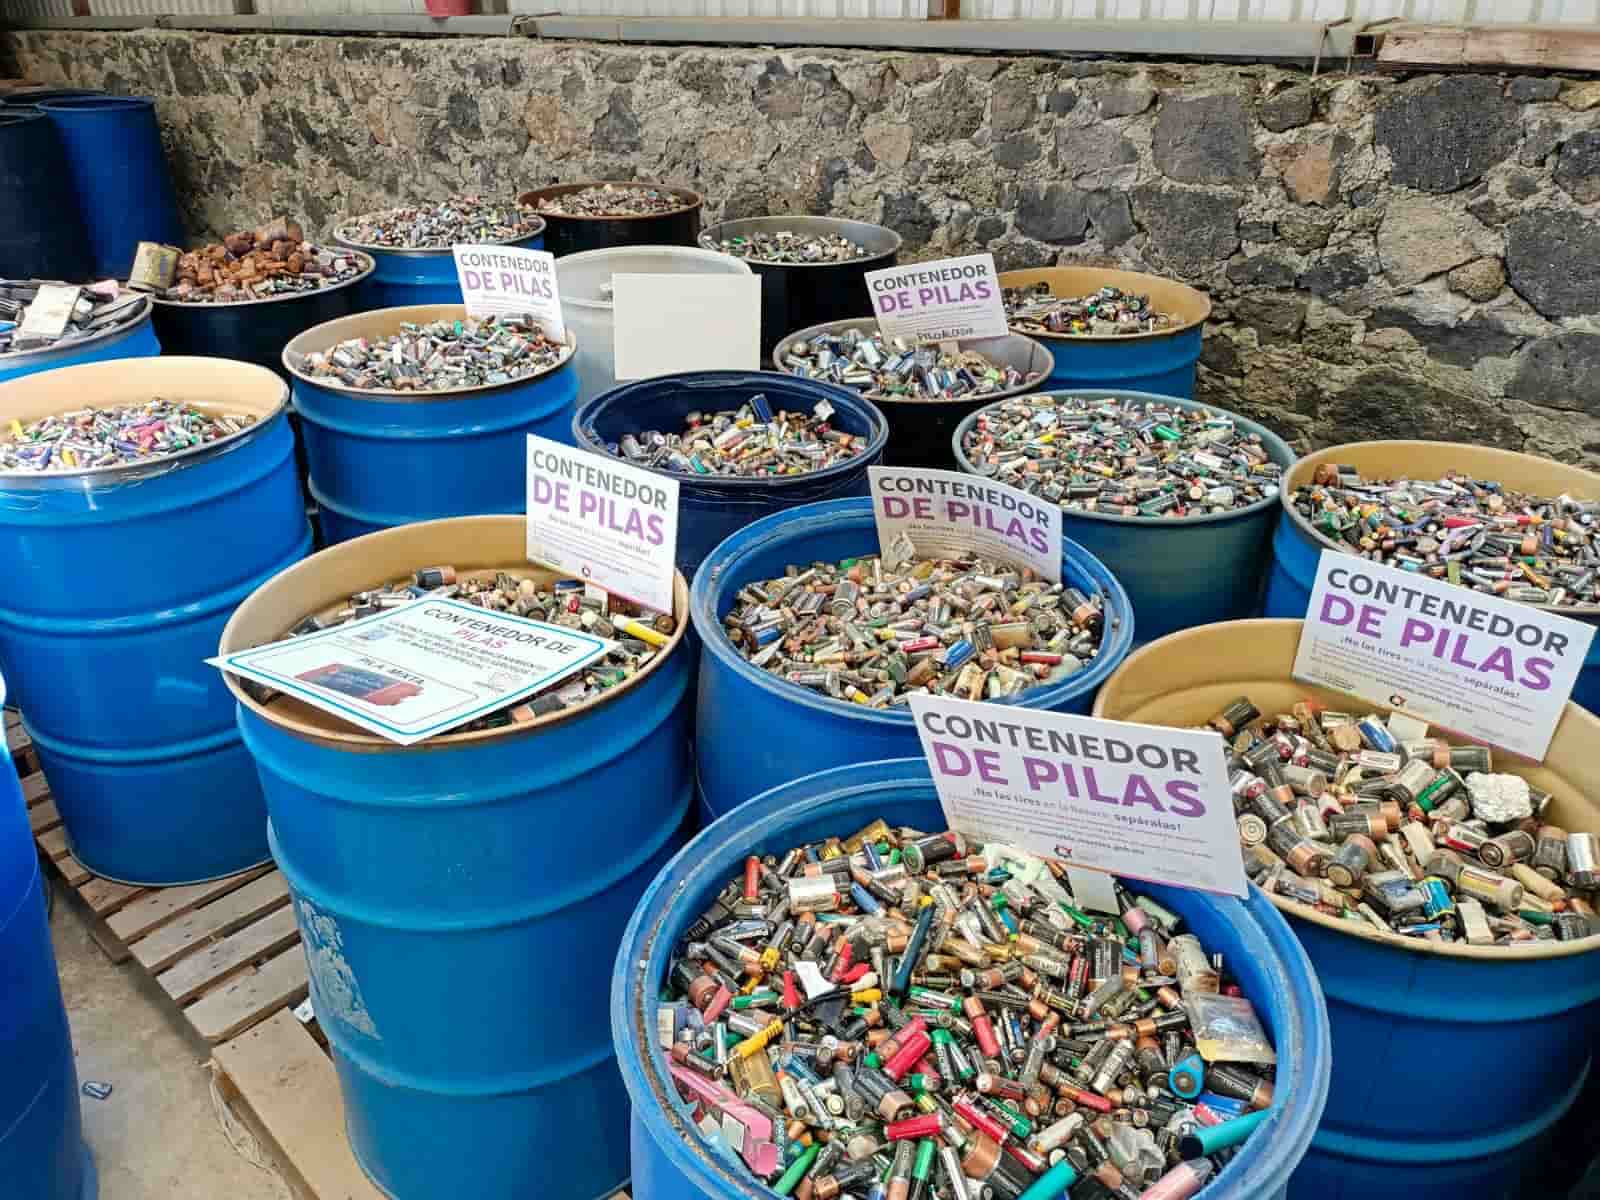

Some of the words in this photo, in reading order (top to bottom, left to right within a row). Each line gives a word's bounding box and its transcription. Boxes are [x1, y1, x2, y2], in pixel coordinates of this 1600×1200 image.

[461, 254, 549, 272] CONTENEDOR
[464, 270, 496, 290] DE
[501, 272, 553, 299] PILAS
[873, 264, 987, 292] CONTENEDOR
[878, 291, 912, 313] DE
[919, 280, 991, 307] PILAS
[533, 449, 667, 510] CONTENEDOR
[878, 477, 1049, 528] CONTENEDOR
[533, 475, 570, 512] DE
[580, 488, 664, 545] PILAS
[883, 496, 935, 520] DE
[946, 501, 1049, 554] PILAS
[423, 607, 547, 648] CONTENEDOR
[547, 635, 577, 656] DE
[1327, 568, 1569, 656] CONTENEDOR
[456, 627, 508, 649] PILAS
[1319, 592, 1387, 638] DE
[1400, 616, 1555, 691] PILAS
[360, 657, 385, 670] PILA
[387, 667, 424, 685] MIXTA
[922, 711, 1202, 774] CONTENEDOR
[932, 741, 1008, 786] DE
[1023, 756, 1206, 818] PILAS
[994, 789, 1010, 800] las
[1013, 793, 1040, 806] tires
[1113, 813, 1181, 833] sepáralas!
